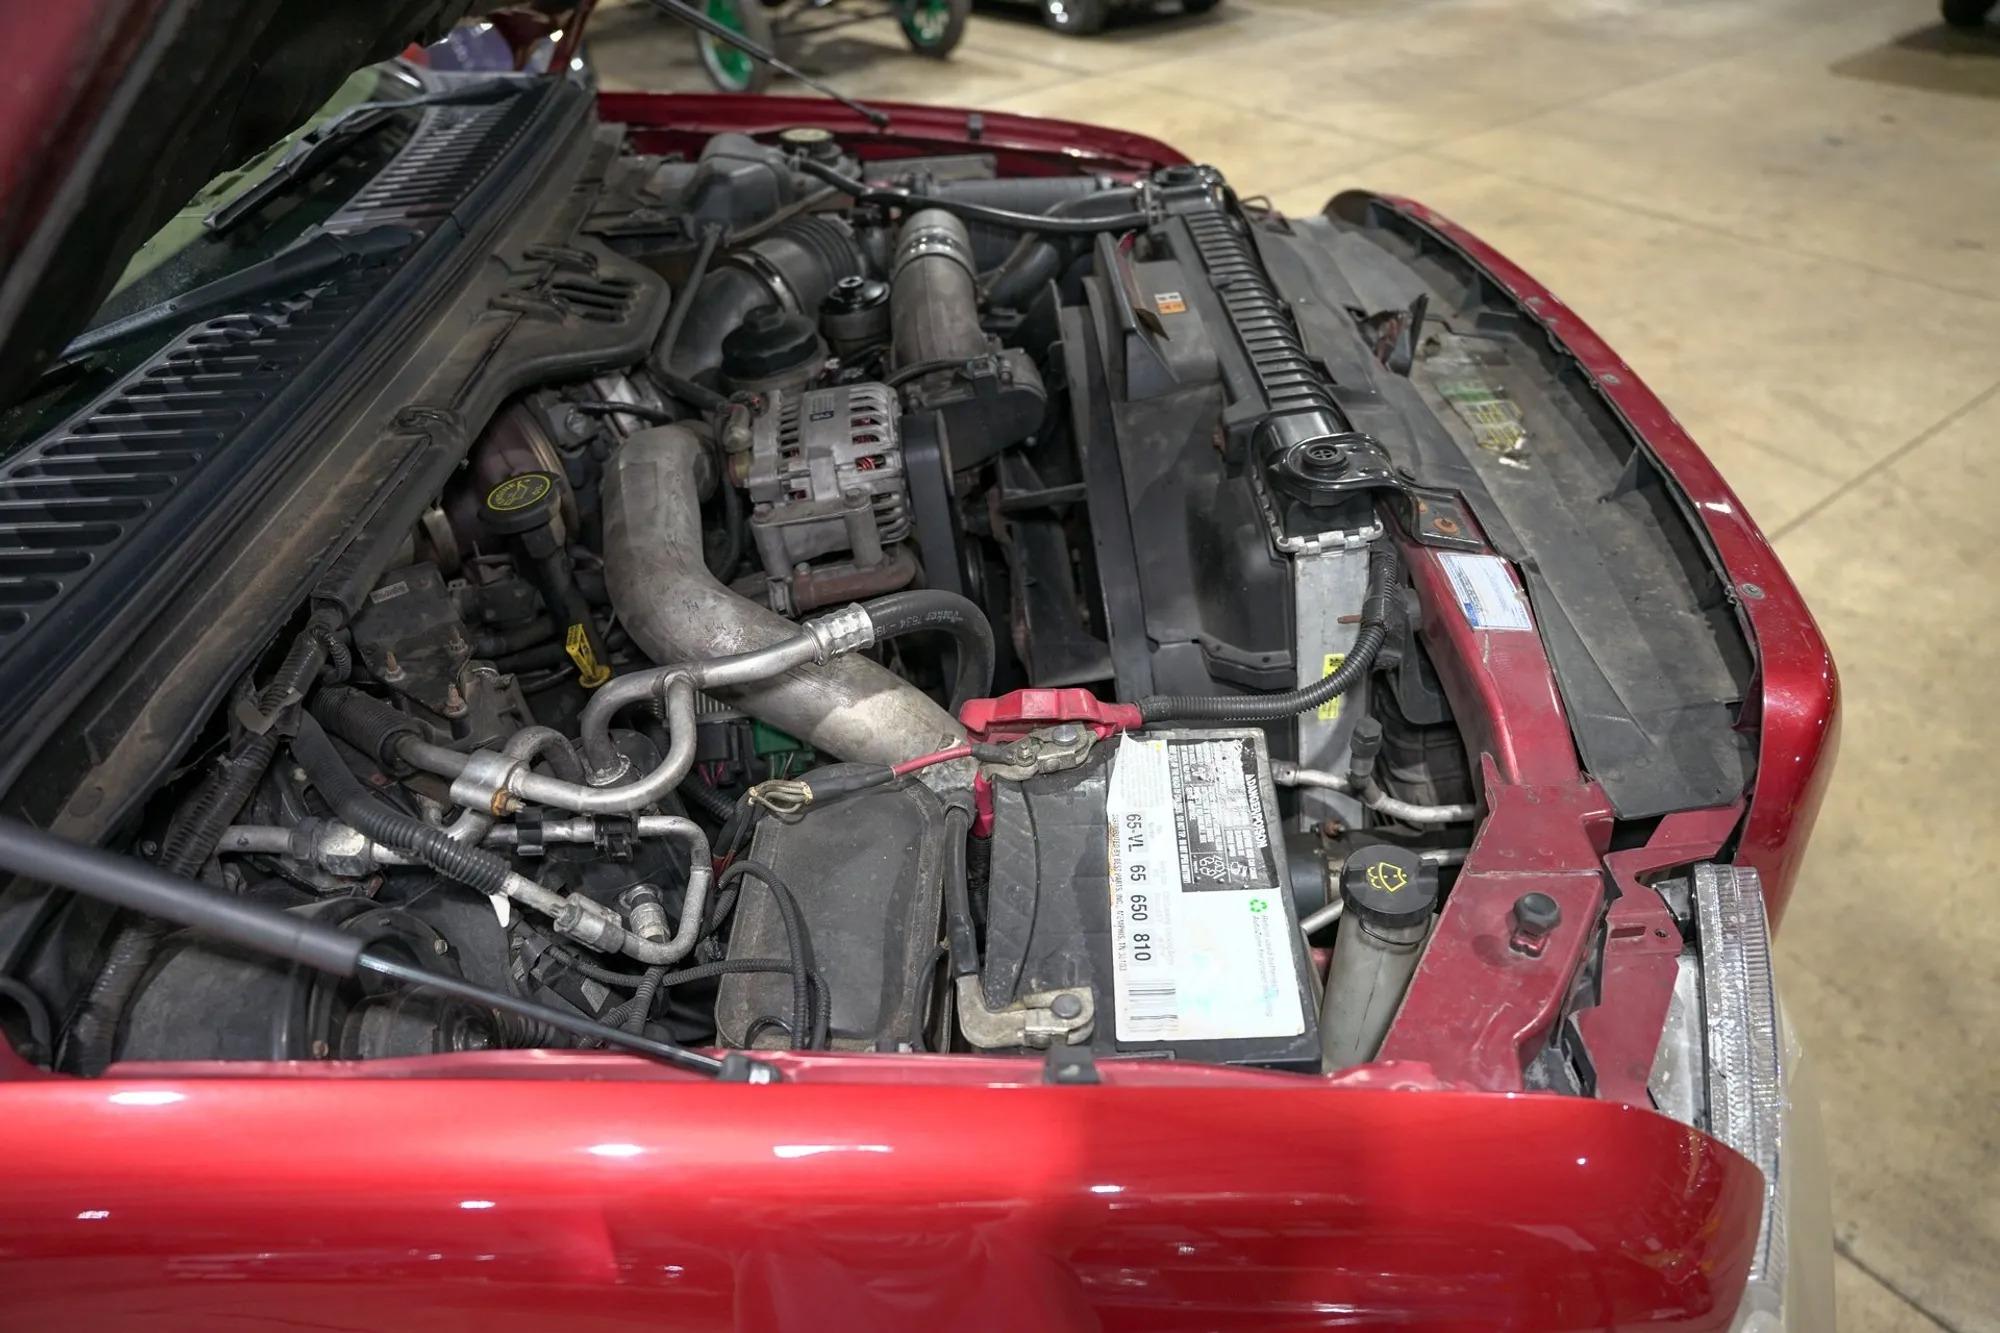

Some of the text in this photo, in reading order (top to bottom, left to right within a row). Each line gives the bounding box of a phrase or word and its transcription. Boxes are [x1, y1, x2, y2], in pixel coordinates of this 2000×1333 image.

[1248, 780, 1268, 848] DANGER/POISON
[1126, 814, 1152, 961] 65-VL 65 650 810
